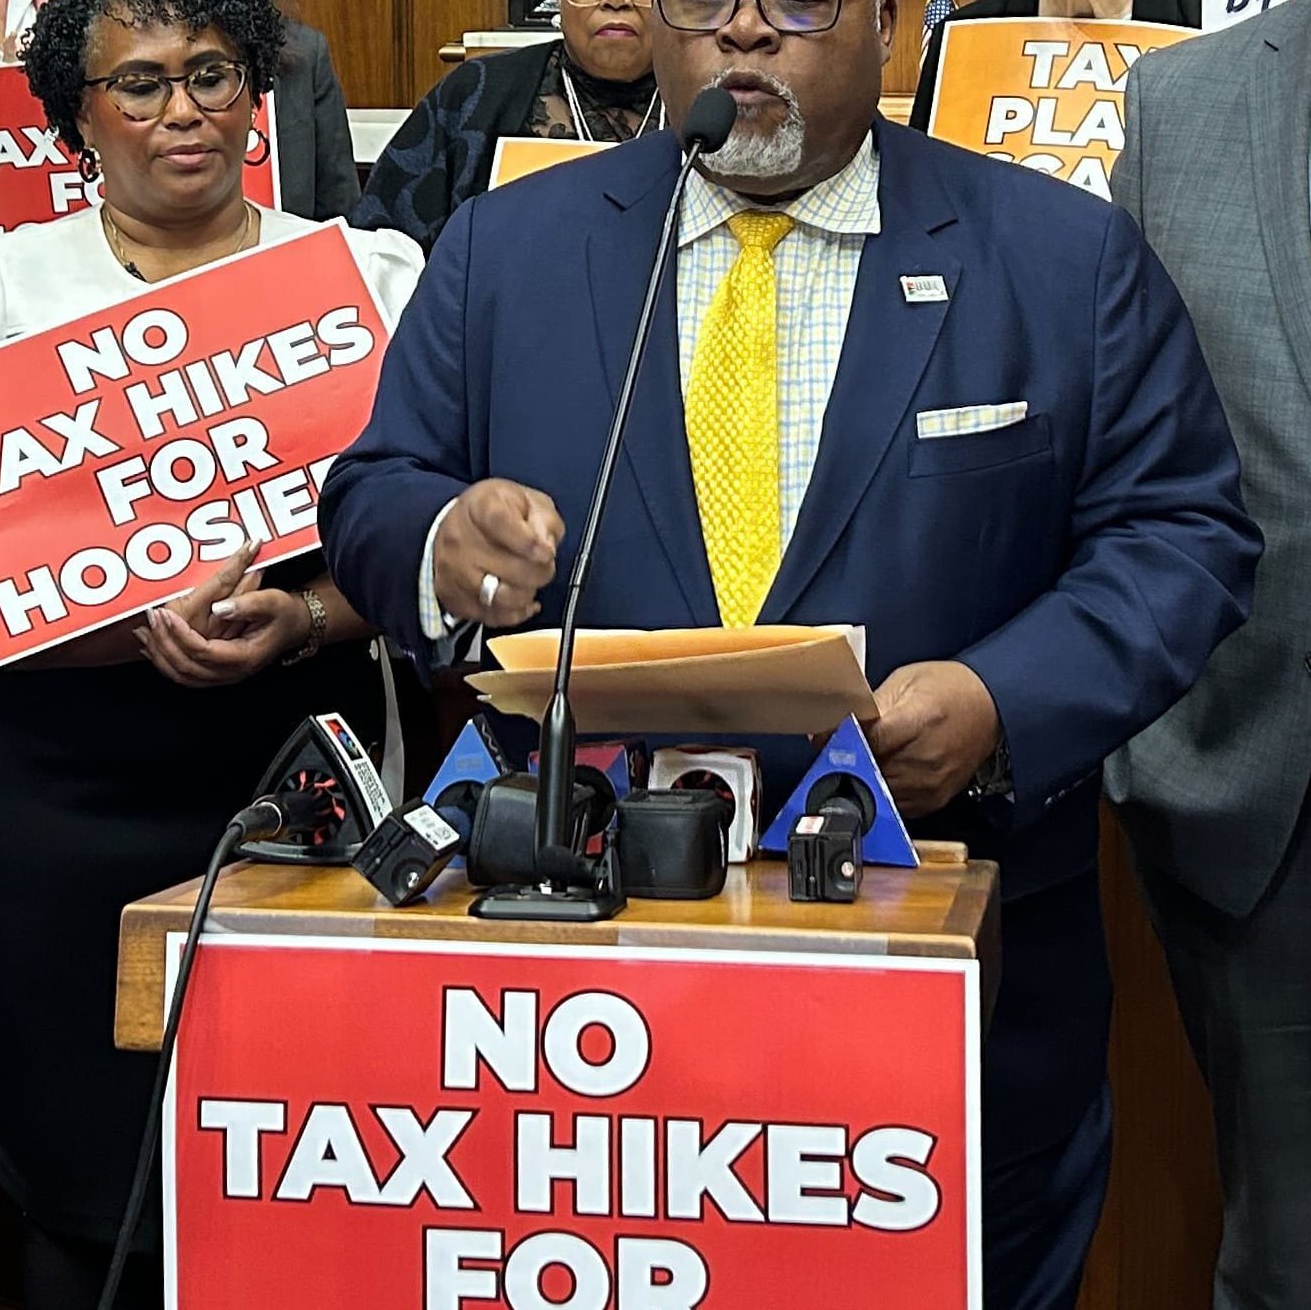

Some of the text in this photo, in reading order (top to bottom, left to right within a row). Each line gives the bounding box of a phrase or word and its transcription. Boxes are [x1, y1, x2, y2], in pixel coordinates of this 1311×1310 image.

[1021, 39, 1158, 92] TAX
[984, 95, 1126, 152] PLA
[55, 306, 191, 396] NO
[125, 304, 376, 441] HIKES
[95, 416, 283, 528] FOR
[439, 984, 653, 1100] NO
[197, 1097, 942, 1233] TAX HIKES
[421, 1225, 711, 1310] FOR
